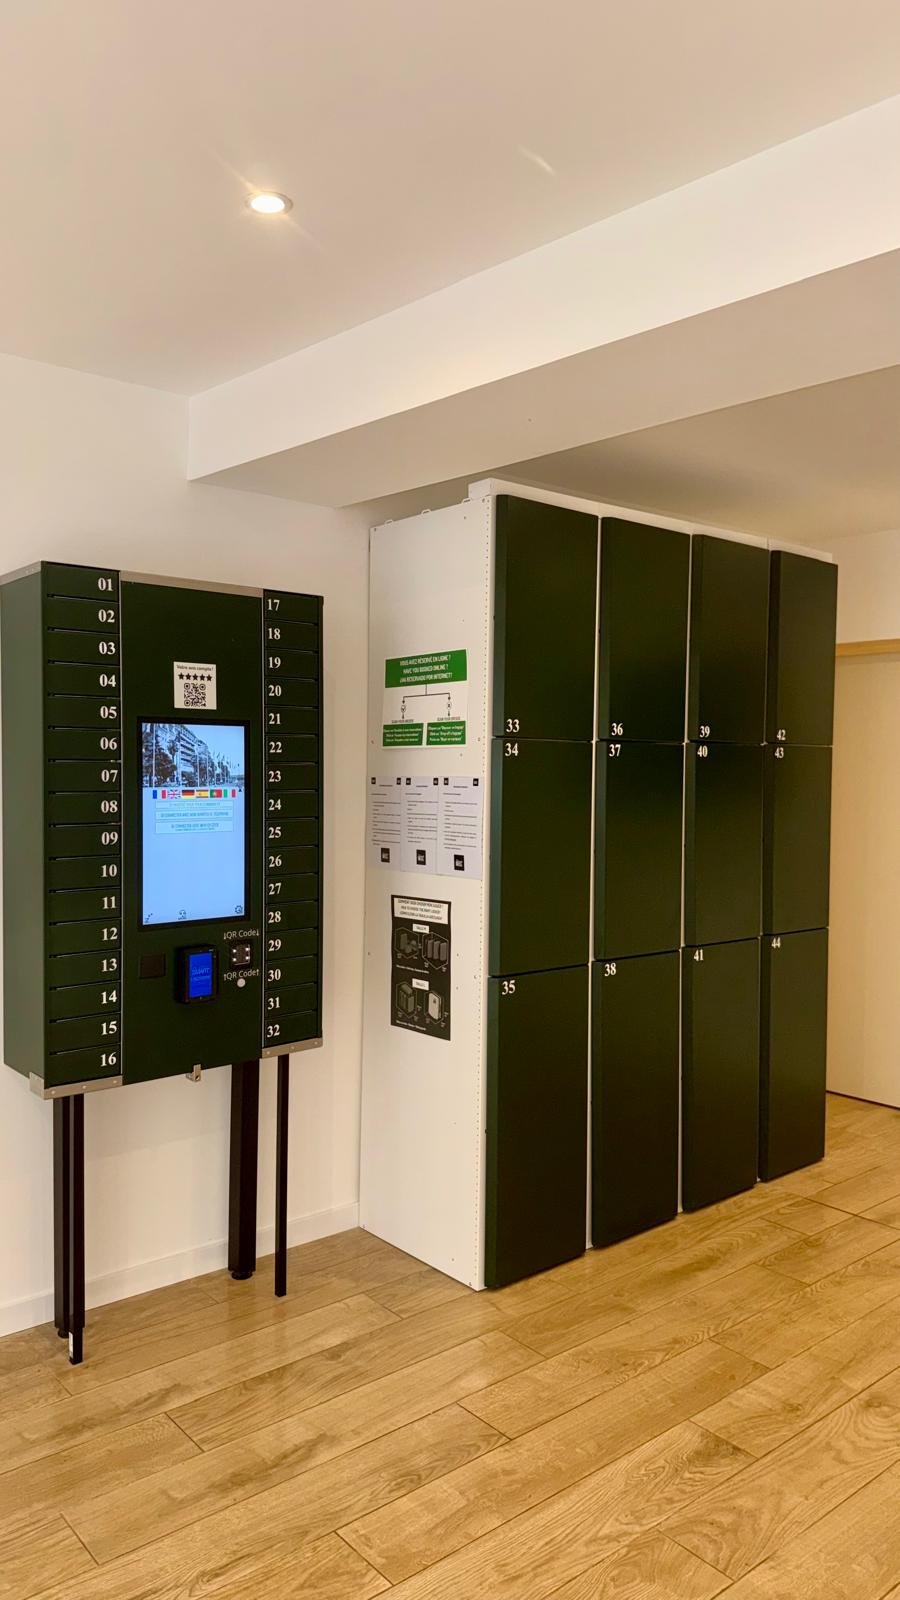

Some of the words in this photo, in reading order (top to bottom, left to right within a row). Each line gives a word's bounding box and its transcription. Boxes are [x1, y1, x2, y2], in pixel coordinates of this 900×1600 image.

[98, 578, 112, 590] 01
[268, 600, 280, 610] 17
[98, 610, 114, 622] 02
[268, 628, 280, 640] 18
[98, 642, 116, 654] 03
[268, 656, 280, 668] 19
[100, 674, 116, 688] 04
[268, 684, 282, 696] 20
[100, 706, 118, 718] 05
[268, 712, 280, 724] 21
[506, 718, 520, 732] 33
[612, 722, 624, 736] 36
[700, 726, 710, 738] 39
[776, 730, 786, 740] 42
[100, 736, 118, 750] 06
[270, 742, 282, 752] 22
[504, 742, 518, 756] 34
[608, 744, 620, 756] 37
[698, 746, 708, 758] 40
[774, 748, 784, 758] 43
[102, 770, 118, 782] 07
[268, 770, 282, 782] 23
[100, 800, 118, 812] 08
[268, 798, 282, 810] 24
[102, 832, 118, 844] 09
[268, 826, 282, 838] 25
[268, 856, 282, 868] 26
[102, 864, 118, 878] 10
[268, 882, 282, 896] 27
[102, 896, 116, 908] 11
[268, 910, 282, 924] 28
[102, 928, 118, 940] 12
[226, 930, 237, 939] QR
[238, 928, 256, 937] Code
[268, 938, 282, 950] 29
[772, 938, 780, 948] 44
[694, 950, 704, 962] 41
[102, 958, 118, 972] 13
[604, 962, 616, 976] 38
[226, 972, 237, 980] QR
[238, 969, 256, 977] Code
[268, 968, 282, 982] 30
[502, 980, 516, 994] 35
[102, 990, 118, 1004] 14
[268, 996, 280, 1010] 31
[102, 1020, 118, 1036] 15
[266, 1024, 280, 1038] 32
[100, 1052, 116, 1066] 16
